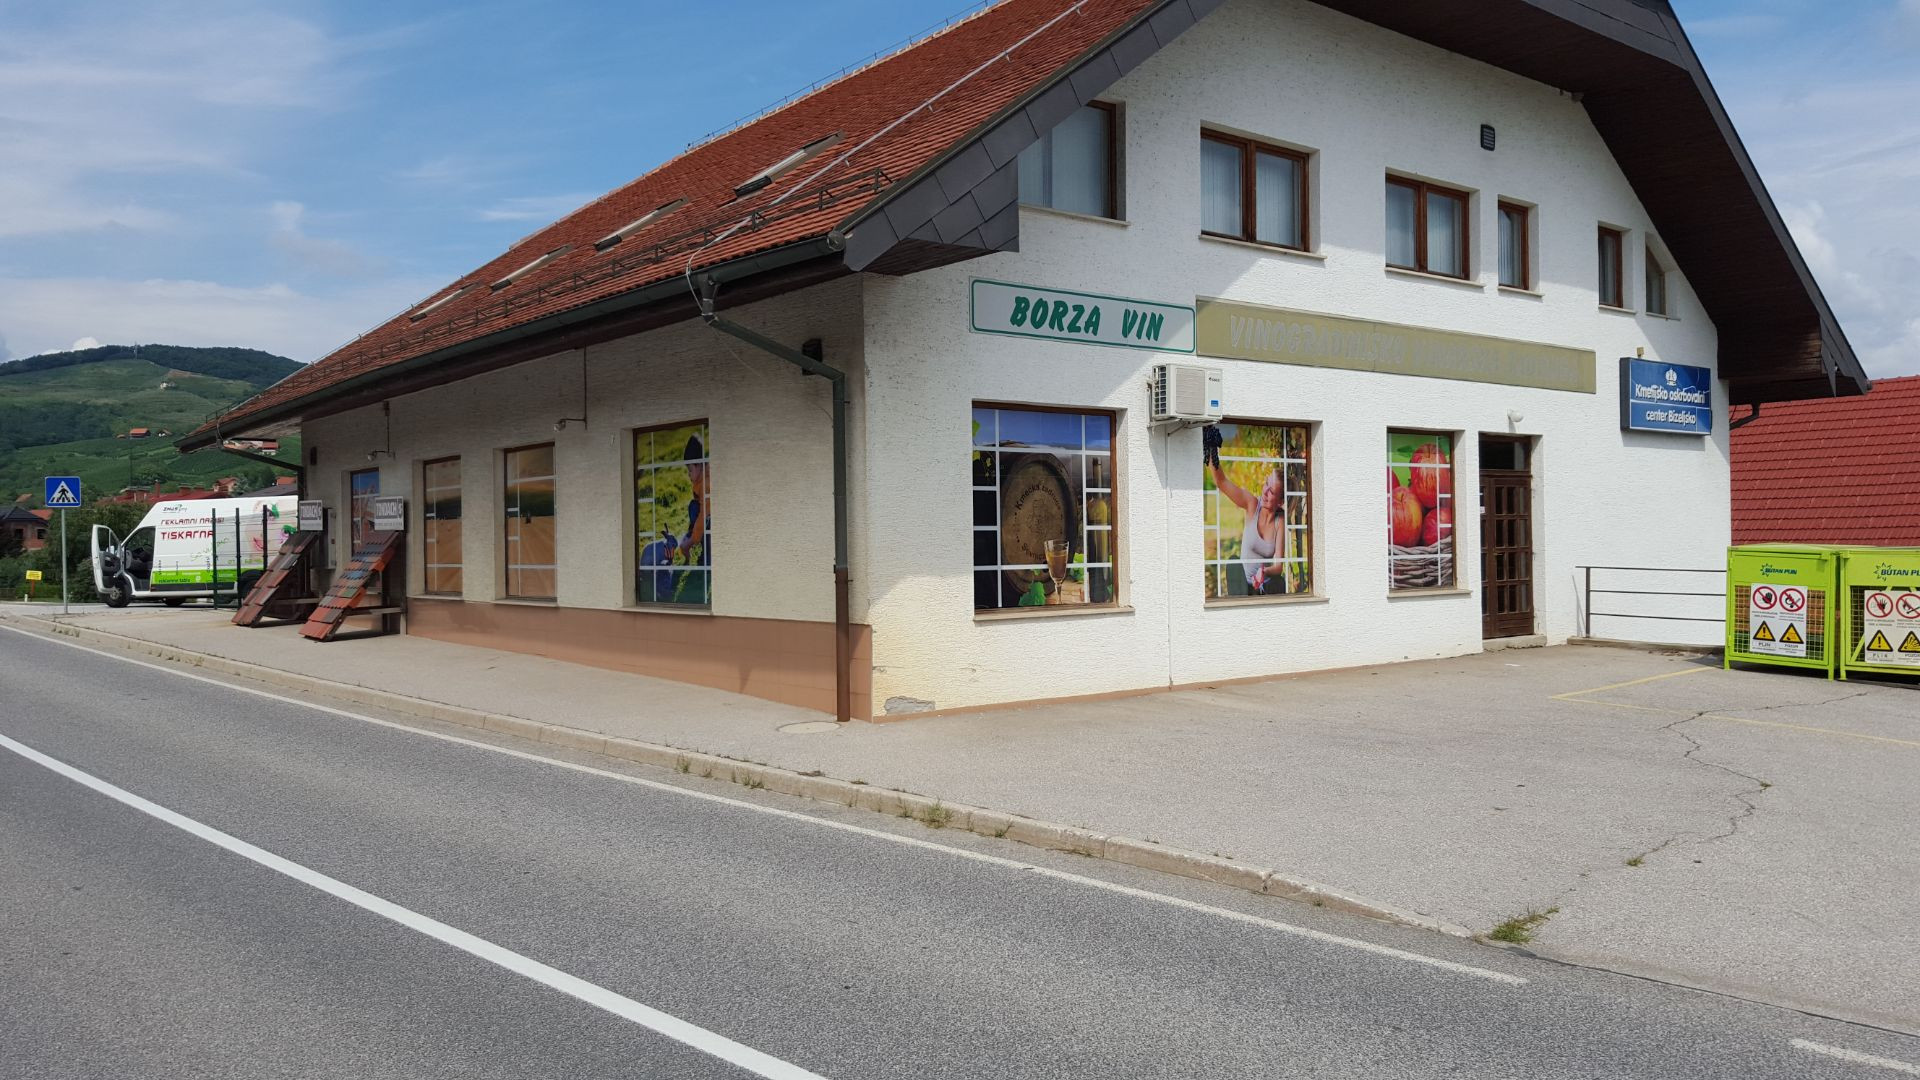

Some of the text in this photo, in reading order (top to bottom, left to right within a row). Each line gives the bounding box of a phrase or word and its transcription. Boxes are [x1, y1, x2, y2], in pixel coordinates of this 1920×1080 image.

[1010, 296, 1164, 341] BORZA VIN
[1635, 384, 1706, 404] Kmetijsko oskrbovalni
[1645, 409, 1696, 427] center Bizeljsko
